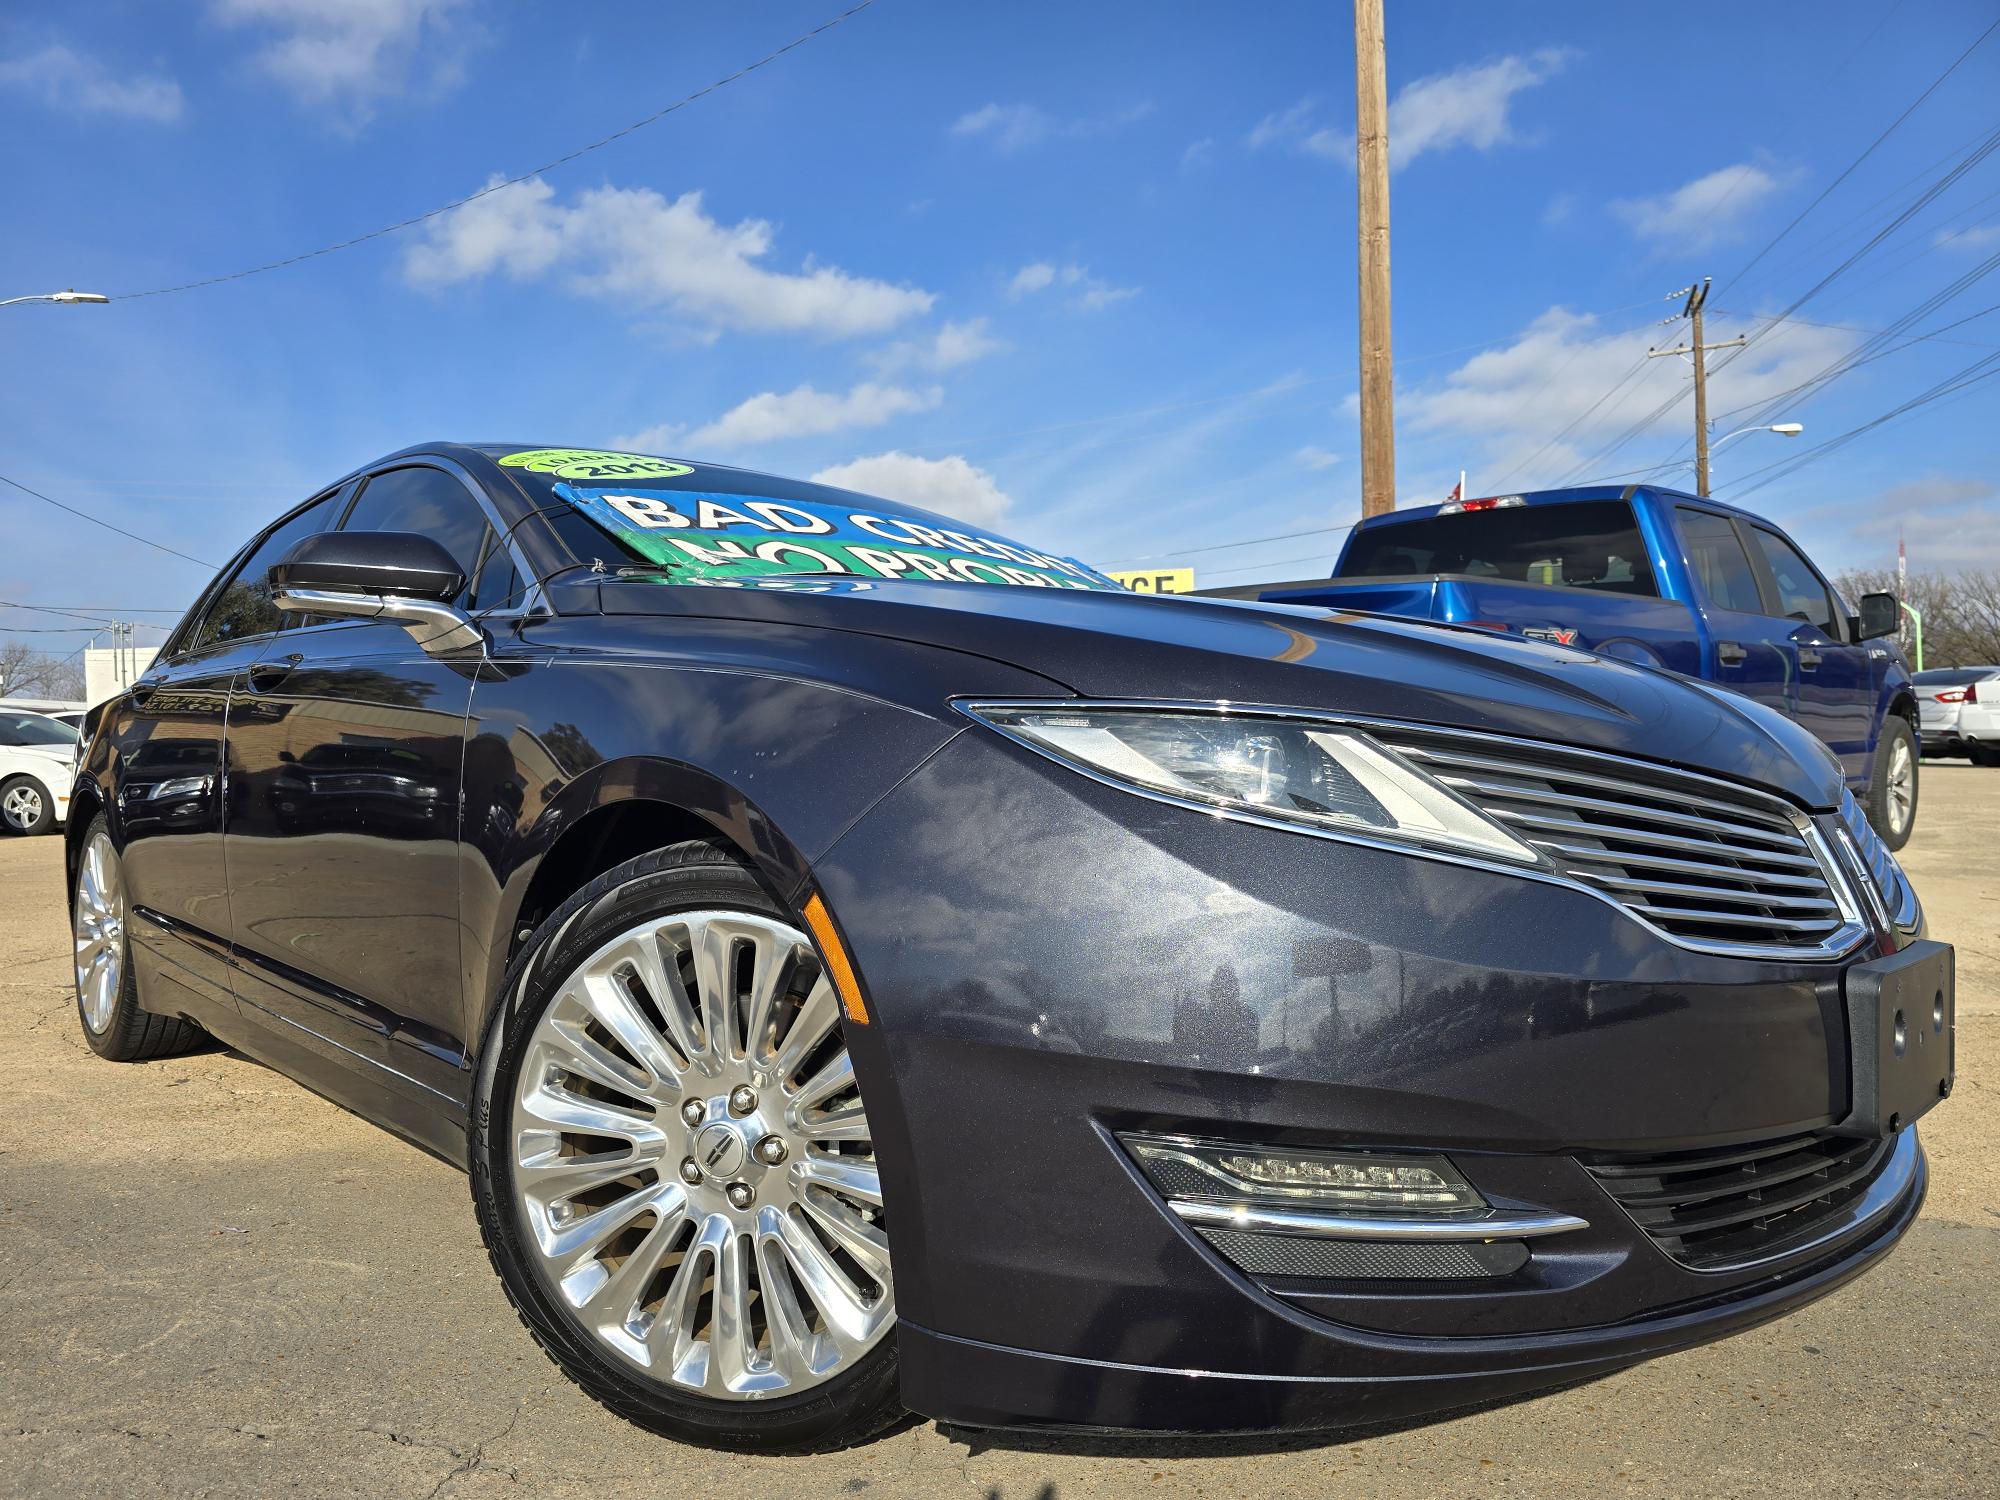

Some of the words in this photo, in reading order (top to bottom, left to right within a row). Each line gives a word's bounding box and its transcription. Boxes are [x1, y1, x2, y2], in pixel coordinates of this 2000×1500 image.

[574, 462, 680, 477] 2013
[602, 495, 837, 535] BAD
[848, 513, 1106, 587] CREDIT
[665, 538, 853, 574] NO
